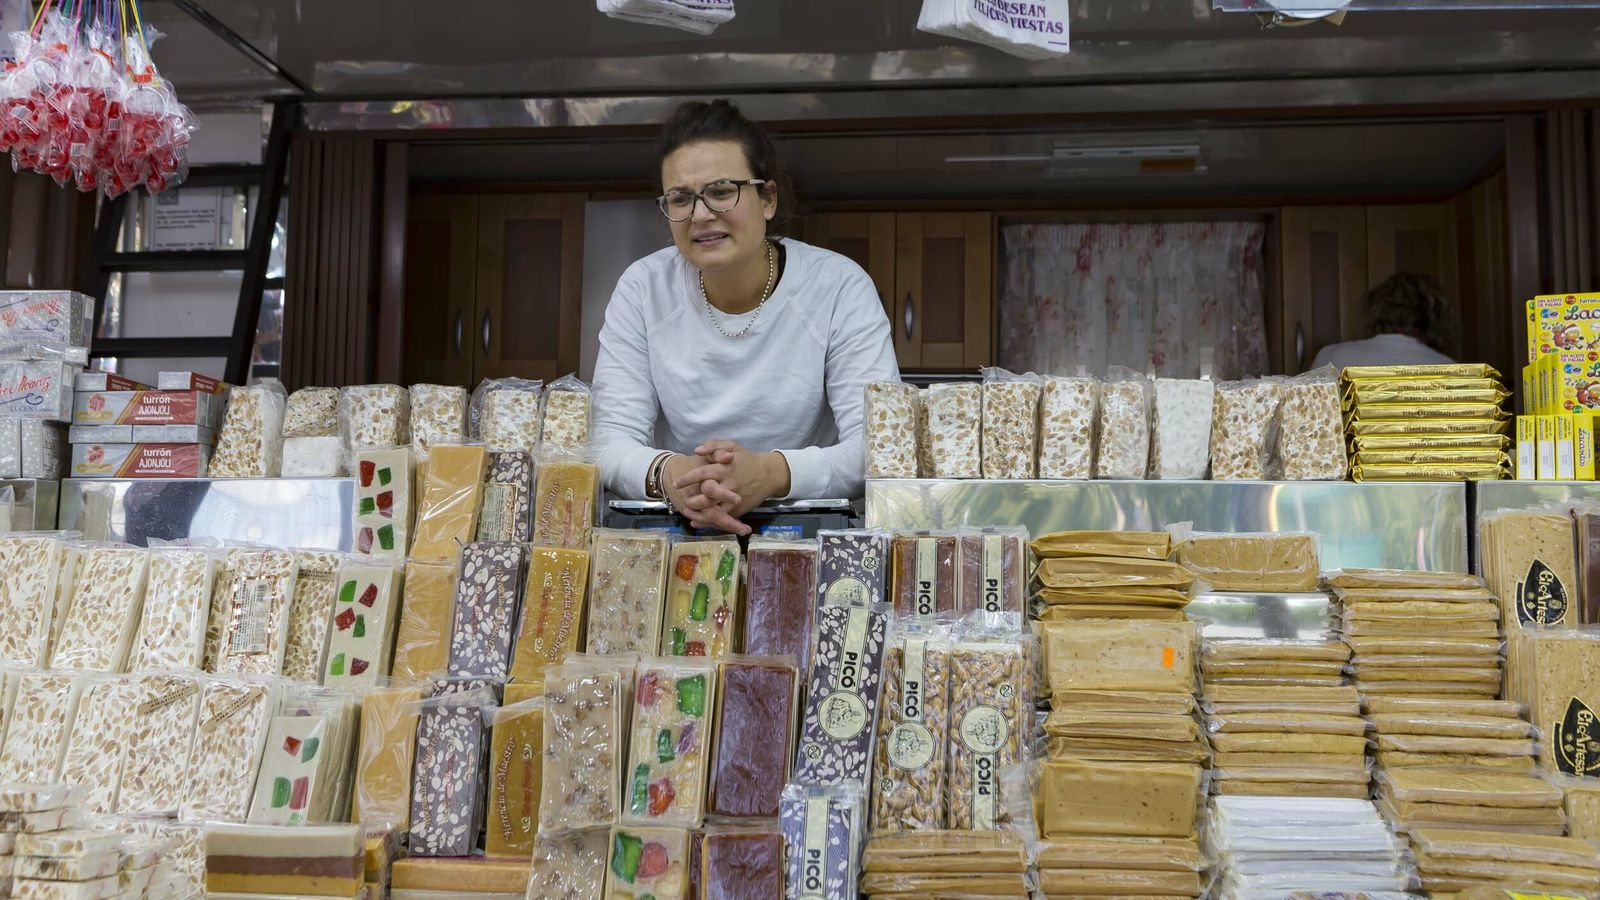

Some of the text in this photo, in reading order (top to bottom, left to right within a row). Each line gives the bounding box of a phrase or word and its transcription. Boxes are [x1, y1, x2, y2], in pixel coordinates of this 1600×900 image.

[1010, 17, 1063, 34] FIESTAS
[138, 405, 170, 415] AJONJOLI
[143, 394, 170, 404] turrón
[139, 458, 171, 468] AJONJOLI
[144, 448, 172, 456] turrón
[918, 580, 932, 615] PICÓ
[986, 578, 1000, 612] PICÓ
[840, 652, 858, 689] PICÓ
[904, 680, 920, 718] PICÓ
[976, 757, 992, 796] PICÓ
[804, 848, 822, 890] PICÓ
